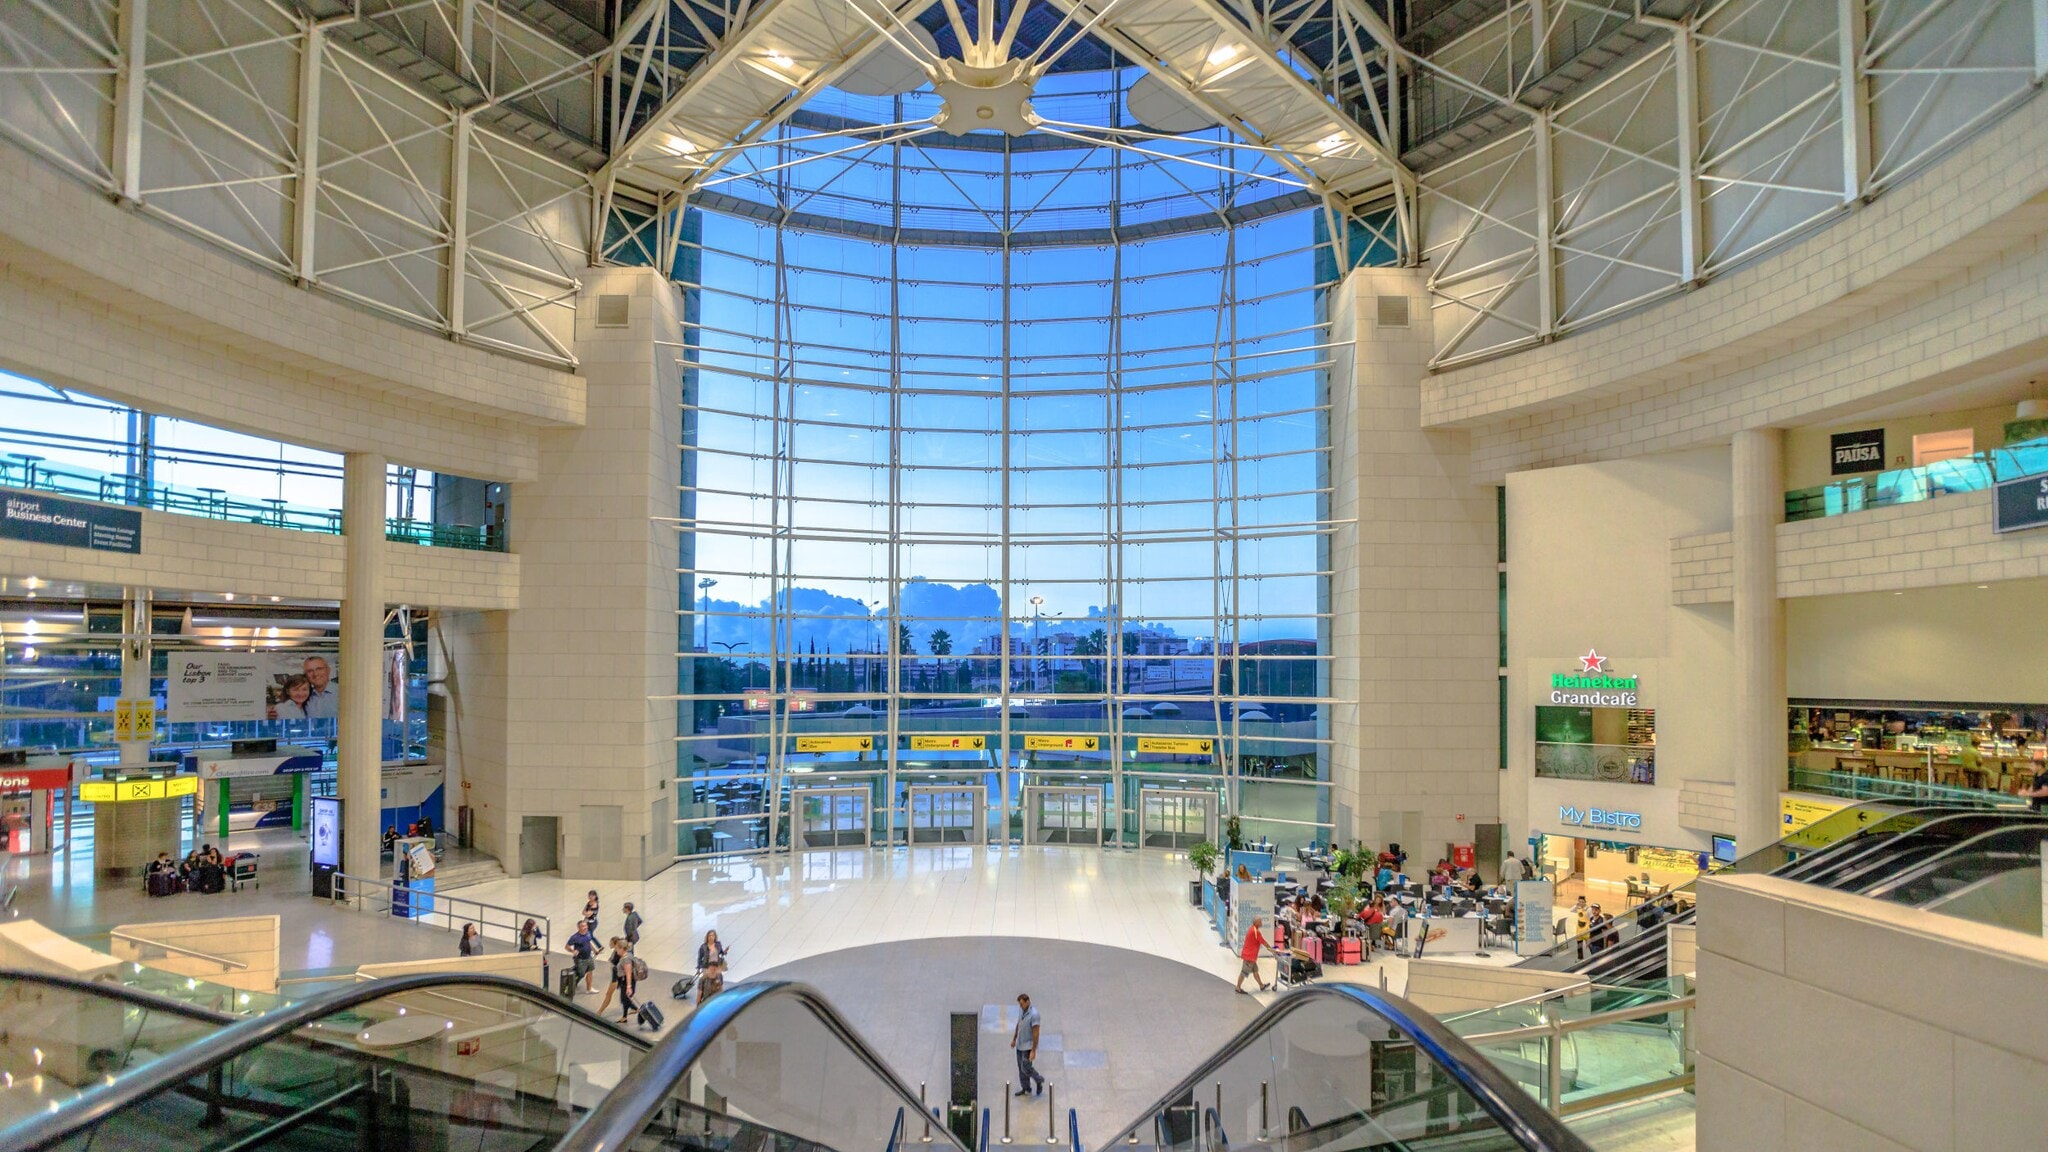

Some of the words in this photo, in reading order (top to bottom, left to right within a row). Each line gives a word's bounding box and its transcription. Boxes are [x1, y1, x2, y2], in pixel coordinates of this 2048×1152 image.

[1835, 446, 1881, 464] PAUSA
[7, 498, 40, 512] airport
[7, 508, 52, 523] Business
[53, 515, 87, 528] Center
[184, 669, 212, 677] Lisbon
[186, 662, 203, 670] Our
[182, 676, 197, 684] top
[1551, 673, 1636, 689] Heineken
[1551, 690, 1636, 706] Grandcafé
[1559, 805, 1585, 824] My
[1590, 807, 1641, 828] Bistro
